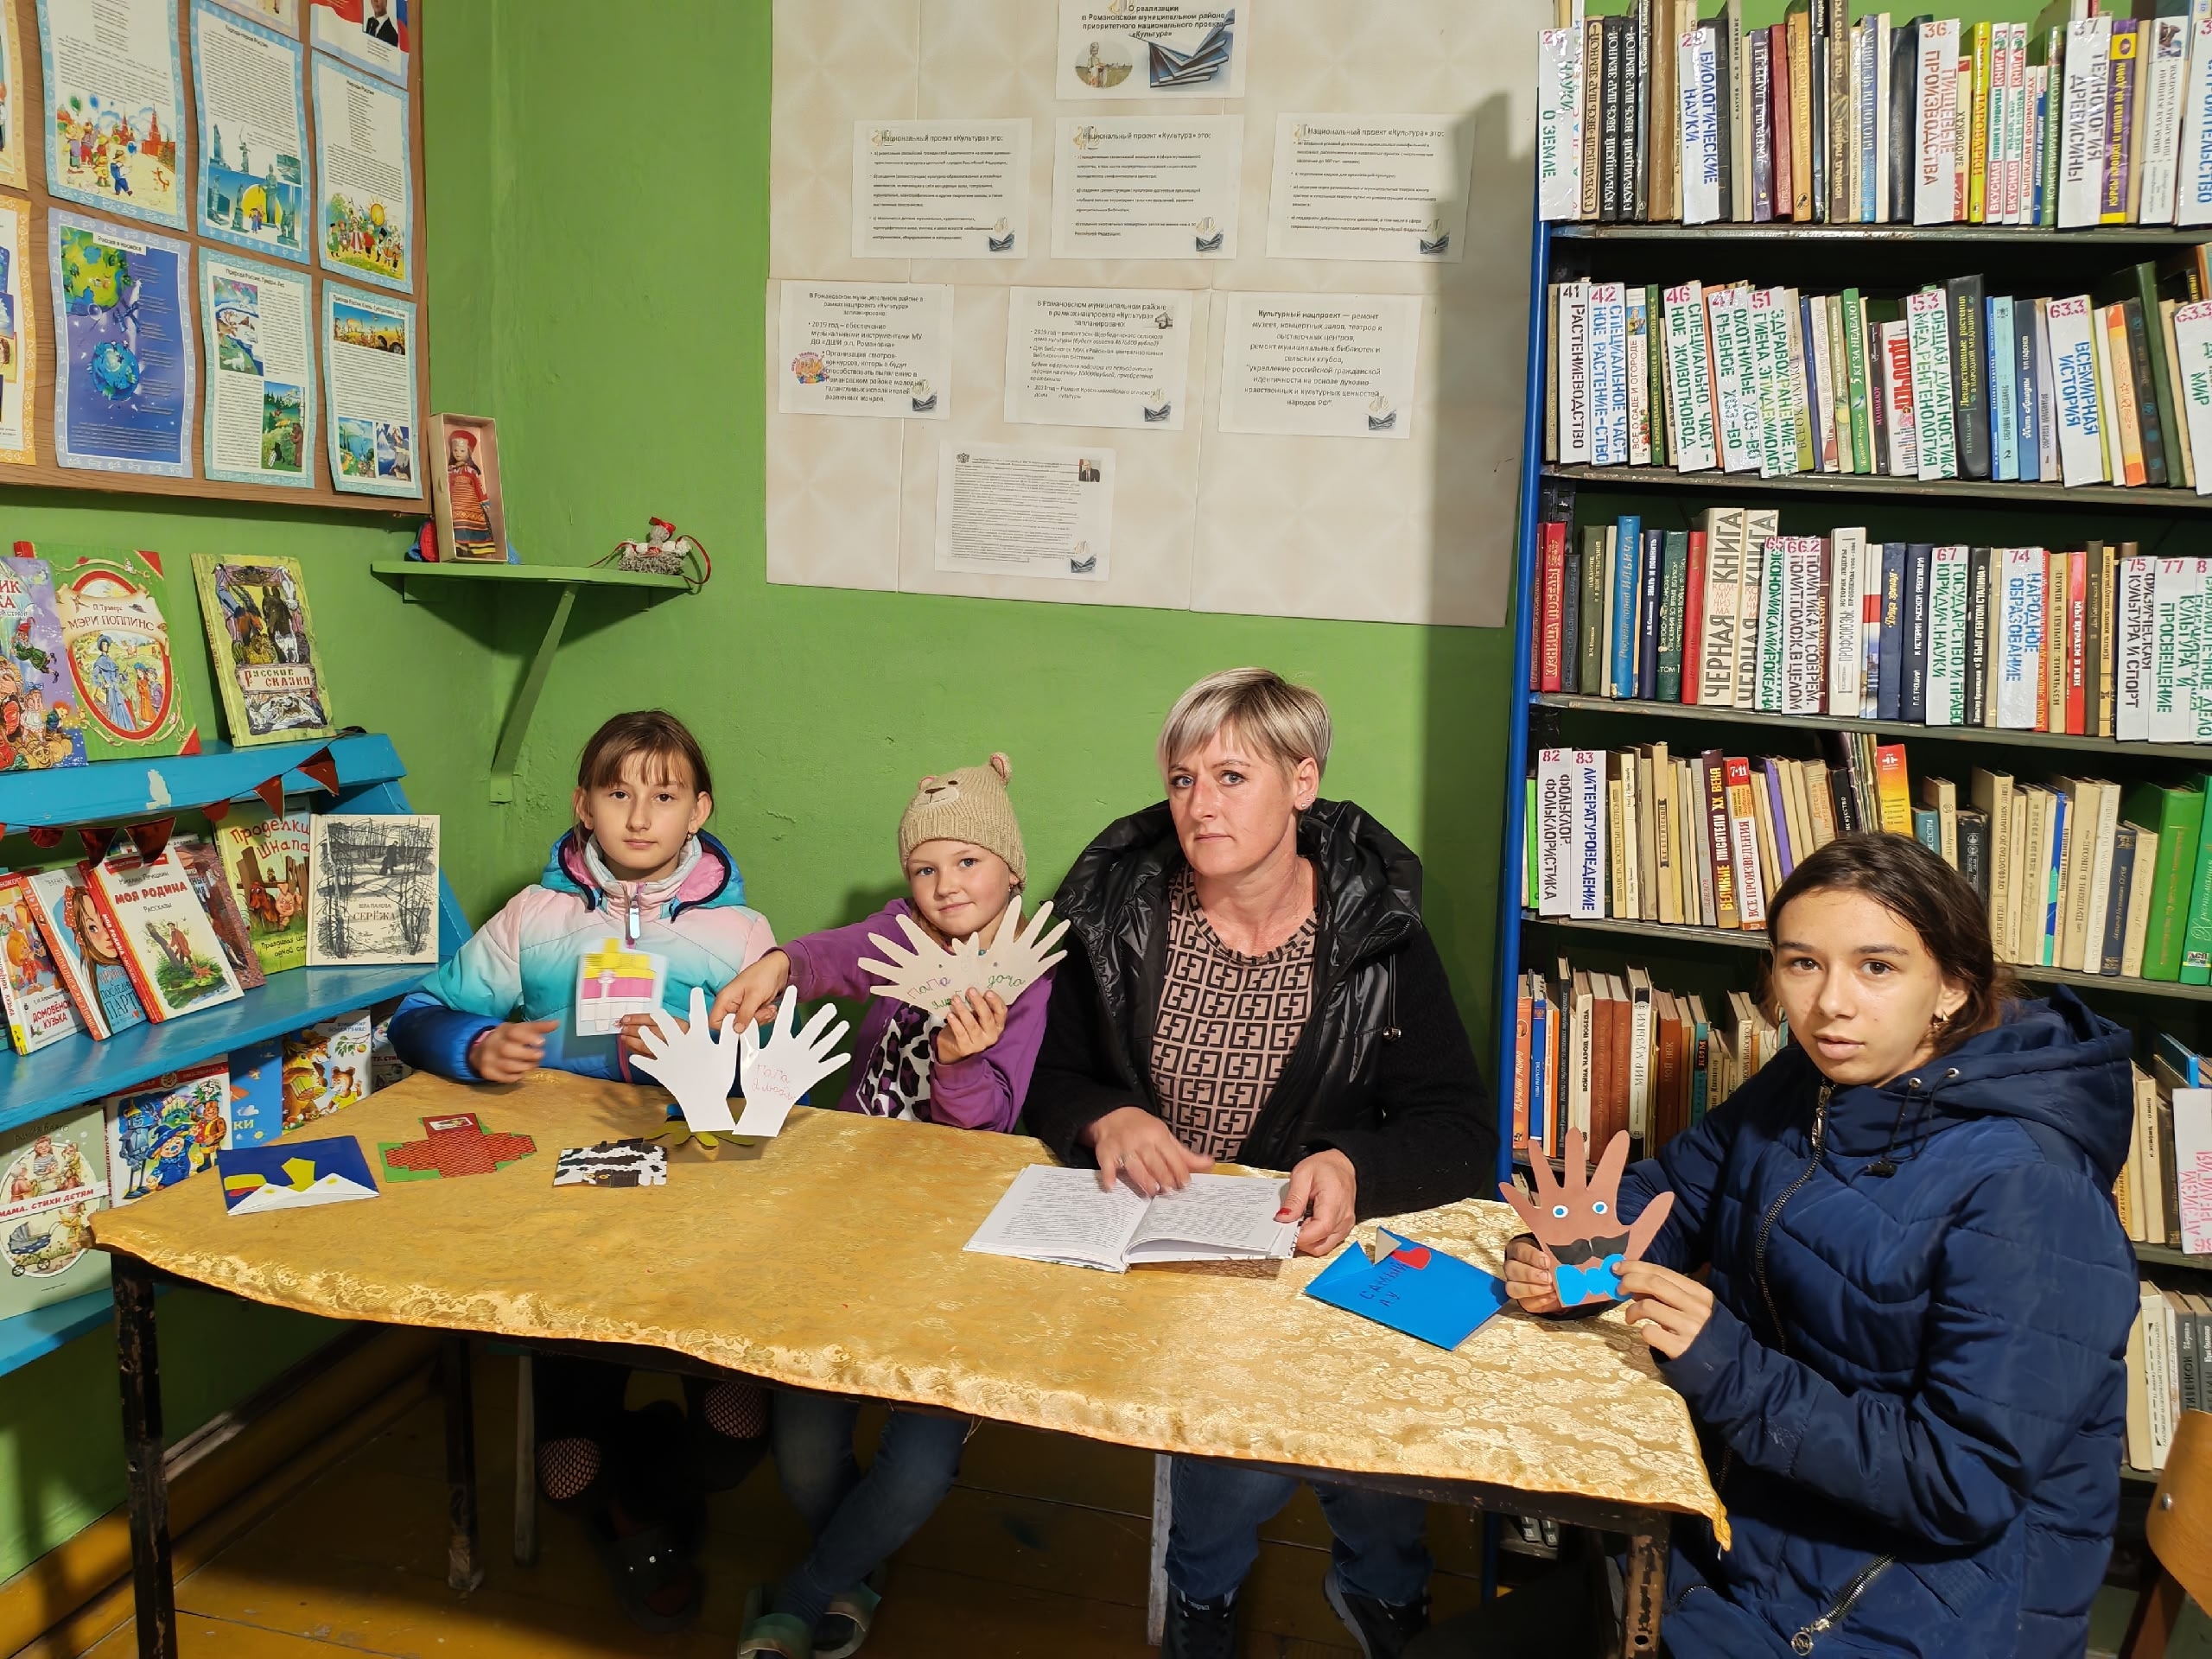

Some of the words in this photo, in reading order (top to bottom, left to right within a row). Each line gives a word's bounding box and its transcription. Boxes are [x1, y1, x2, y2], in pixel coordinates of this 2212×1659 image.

[1542, 110, 1556, 121] О
[1700, 51, 1718, 186] БИОЛОГИЧЕСКИЕ
[1923, 50, 1941, 187] ПРОИЗВОДСТВА
[1941, 69, 1956, 154] ПИЩЕВЫЕ
[2024, 76, 2035, 136] ФОРМОЧКАХ
[2088, 52, 2108, 162] ТЕХНОЛОГИЯ
[1083, 131, 1132, 140] Национальный
[1834, 118, 1844, 157] ЛОРЕНЦ
[1989, 162, 2001, 213] ВКУСНАЯ
[1995, 50, 2005, 86] КНИГА
[2006, 162, 2017, 211] ВКУСНАЯ
[2012, 50, 2022, 86] КНИГА
[1542, 124, 1557, 183] ЗЕМЛЕ.
[2024, 145, 2032, 197] ВЫПЕКАЕМ
[1834, 161, 1843, 199] КОНРАД
[1562, 285, 1580, 298] 41
[1592, 285, 1617, 302] 42
[1666, 285, 1691, 302] 46
[1912, 292, 1940, 311] 53
[1303, 311, 1341, 320] нацпроект
[1592, 307, 1607, 338] НОЕ
[1931, 309, 1949, 364] ОБЩАЯ
[1570, 304, 1586, 449] РАСТЕНИЕВОДСТВО
[1609, 304, 1625, 413] СПЕЦИАЛЬНОЕ
[1630, 339, 1638, 384] ОГОРОДЕ
[1960, 340, 1968, 406] Лекарственные
[1592, 342, 1609, 463] РАСТЕНИЕ-СТВО
[1873, 387, 1883, 425] МАНИКЮР
[2058, 354, 2081, 427] ИСТОРИЯ
[2075, 341, 2100, 435] ВСЕМИРНАЯ
[2190, 373, 2210, 404] МИР
[1611, 418, 1626, 463] ЧАСТ-
[1935, 372, 1955, 479] ДИАГНОСТИКА
[1713, 512, 1744, 583] КНИГА
[1787, 539, 1820, 554] 66.2
[1937, 548, 1956, 562] 67
[2009, 550, 2031, 563] 74
[2127, 558, 2146, 572] 75
[2055, 569, 2063, 602] ШКОЛЕ
[2162, 560, 2184, 574] 77
[1713, 582, 1738, 591] КОМ-
[1805, 555, 1820, 626] ПОЛИТИКА
[67, 615, 100, 631] МЭРИ
[101, 615, 154, 631] ПОППИНС
[1951, 563, 1967, 666] ГОСУДАРСТВО
[2024, 572, 2041, 653] НАРОДНОЕ
[2074, 601, 2083, 617] МЫ
[2126, 575, 2141, 642] КУЛЬТУРА
[1805, 627, 1817, 639] И
[2006, 577, 2024, 683] ОБРАЗОВАНИЕ
[2053, 615, 2062, 652] ЛИРИКИ
[2073, 619, 2082, 657] ИГРАЕМ
[2177, 594, 2195, 668] КУЛЬТУРА
[1704, 615, 1735, 696] ЧЕРНАЯ
[2126, 646, 2139, 656] И
[2157, 603, 2175, 713] ПРОСВЕЩЕНИЕ
[265, 676, 311, 688] СКАЗКИ
[1805, 643, 1820, 706] СОВРЕМ.
[1951, 669, 1963, 680] И
[2126, 660, 2139, 709] СПОРТ
[2176, 677, 2190, 687] И
[1949, 681, 1963, 726] ПРАВО
[1541, 750, 1560, 762] 82
[1576, 752, 1593, 764] 83
[231, 817, 309, 845] Проделки
[1543, 778, 1557, 900] ФОЛЬКЛОРИСТИКА
[1581, 767, 1597, 912] ЛИТЕРАТУРОВЕДЕНИЕ
[1738, 821, 1755, 899] ПРОИЗВЕДЕНИЯ
[114, 890, 140, 905] МОЯ
[143, 881, 188, 900] РОДИНА
[1747, 899, 1759, 918] ВСЕ
[102, 913, 112, 929] МОЯ
[109, 929, 125, 956] РОДИНА
[353, 911, 396, 922] СЕРЁЖА
[261, 938, 294, 951] Правдивая
[274, 947, 294, 957] одной
[5, 994, 16, 1018] КУЗЬКА
[32, 999, 73, 1023] ДОМОВЁНОК
[43, 1013, 67, 1029] КУЗЬКА
[1637, 1013, 1647, 1059] МУЗЫКИ
[1698, 1040, 1707, 1066] КИМ
[1634, 1063, 1644, 1086] МИР
[31, 1197, 60, 1210] СТИХИ
[63, 1189, 94, 1203] ДЕТЯМ
[2179, 1170, 2200, 1236] АТЕИЗМ
[2196, 1151, 2212, 1222] РЕЛИГИЯ
